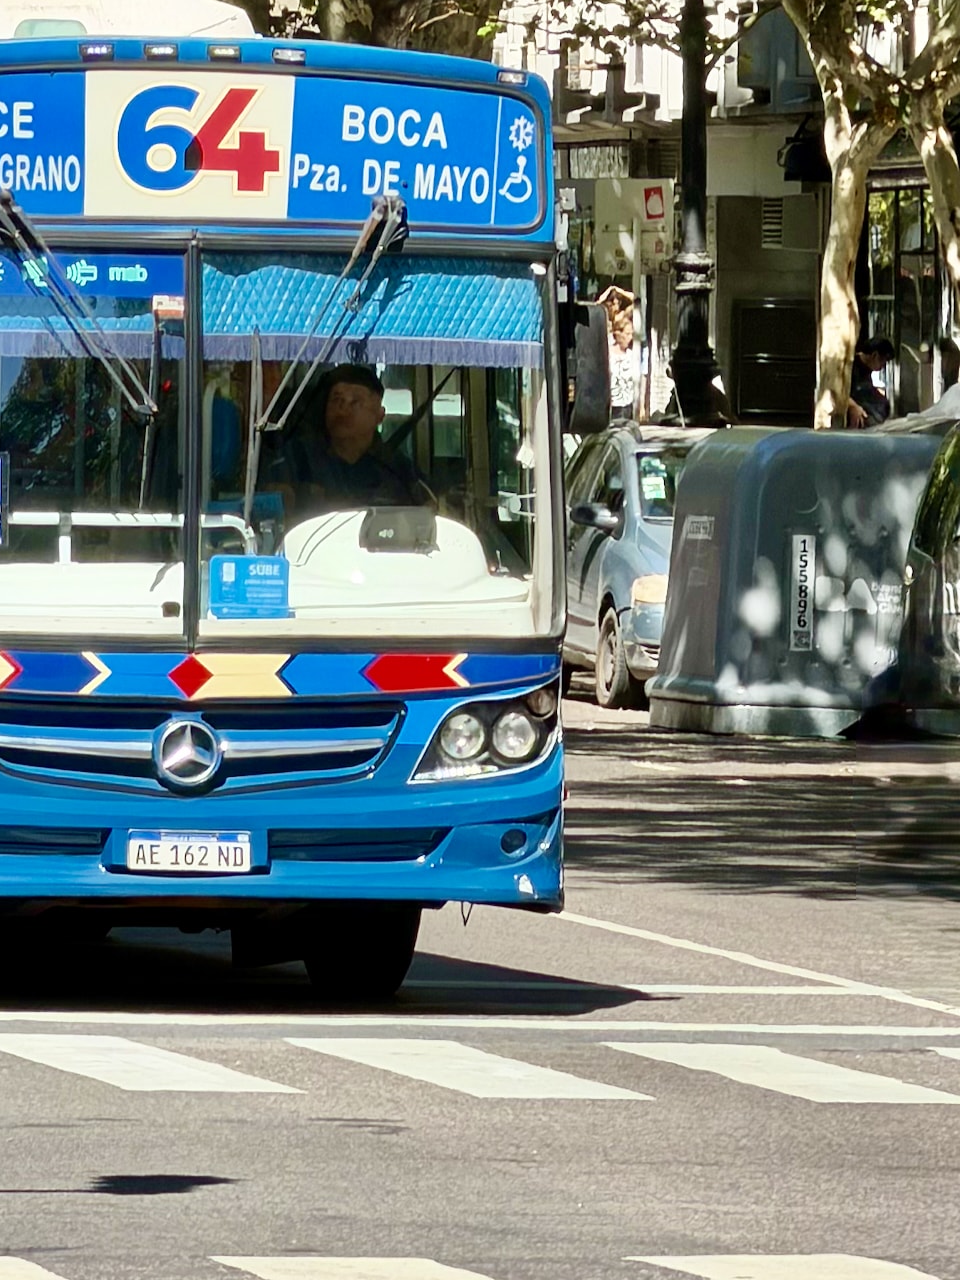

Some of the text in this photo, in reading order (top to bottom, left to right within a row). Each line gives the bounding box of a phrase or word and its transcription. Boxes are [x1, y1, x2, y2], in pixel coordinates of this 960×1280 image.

[114, 81, 283, 197] 64
[342, 104, 447, 149] BOCA
[292, 153, 490, 205] Pza. DE MAYO
[248, 563, 280, 576] SUBE
[796, 538, 809, 629] 155896
[877, 592, 901, 604] Aire
[136, 844, 244, 867] AE 162 ND
